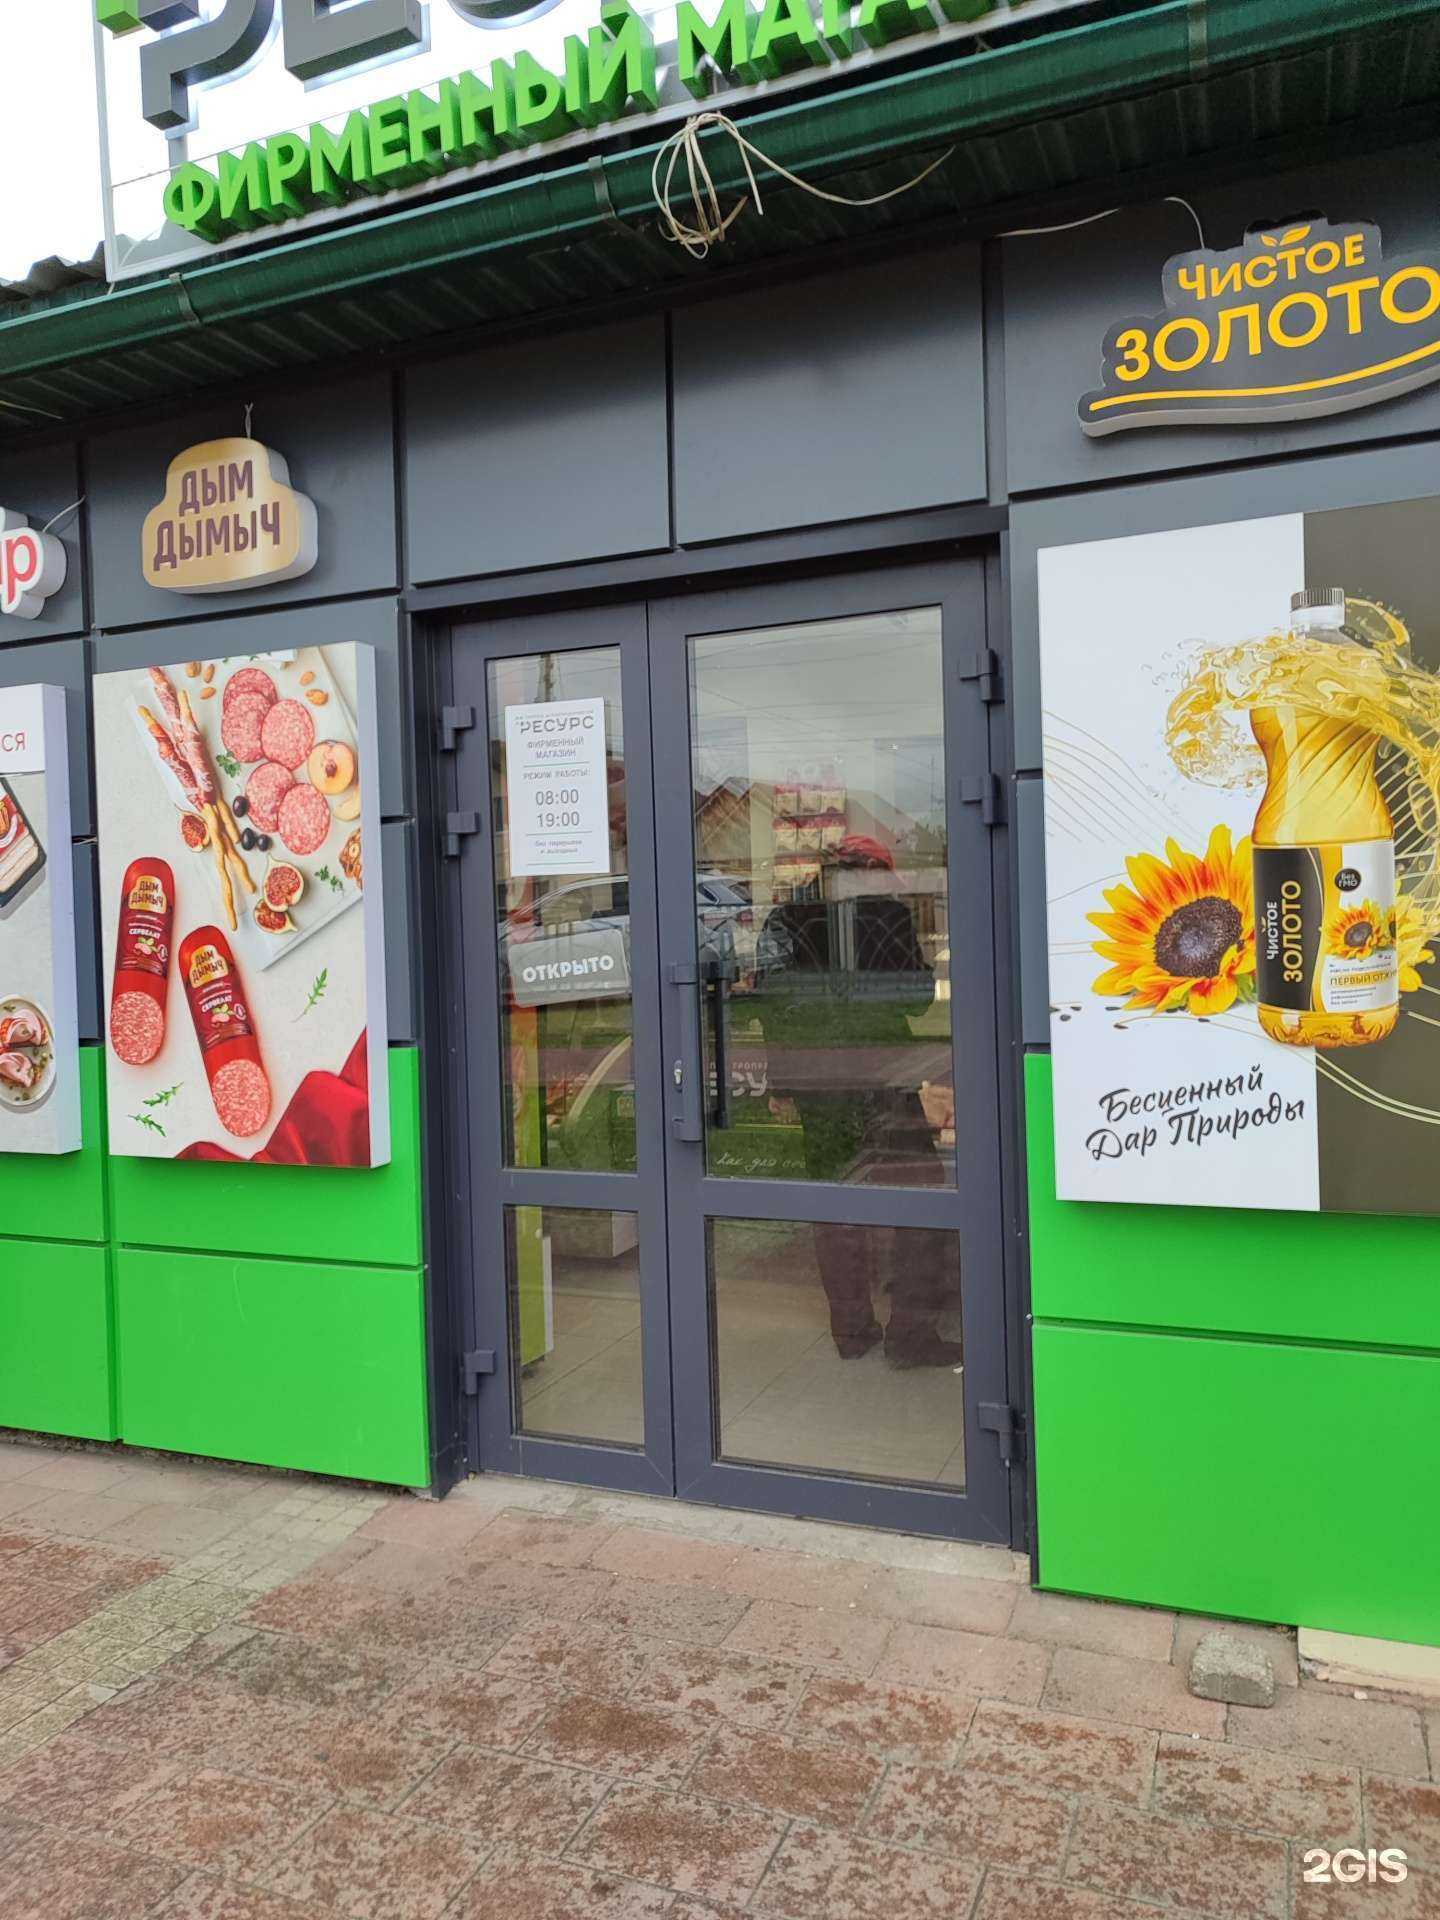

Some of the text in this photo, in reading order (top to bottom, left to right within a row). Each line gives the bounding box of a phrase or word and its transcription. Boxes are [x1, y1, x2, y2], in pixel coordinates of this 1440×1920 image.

[162, 0, 656, 240] ФИРМЕННЫЙ
[1177, 233, 1366, 300] ЧИСТОЕ
[1115, 266, 1440, 382] ЗОЛОТО
[178, 460, 254, 517] ДЫМ
[153, 502, 281, 571] ДЫМЫЧ
[517, 715, 595, 734] РЕСУРС
[535, 788, 579, 806] 08:00
[537, 811, 580, 828] 19:00
[1267, 902, 1278, 960] ЧИСТОЕ
[1281, 880, 1304, 983] ЗОЛОТО
[522, 955, 615, 983] ОТКРЫТО
[1098, 1063, 1265, 1123] Бесценный
[1085, 1092, 1305, 1161] Дар Природы
